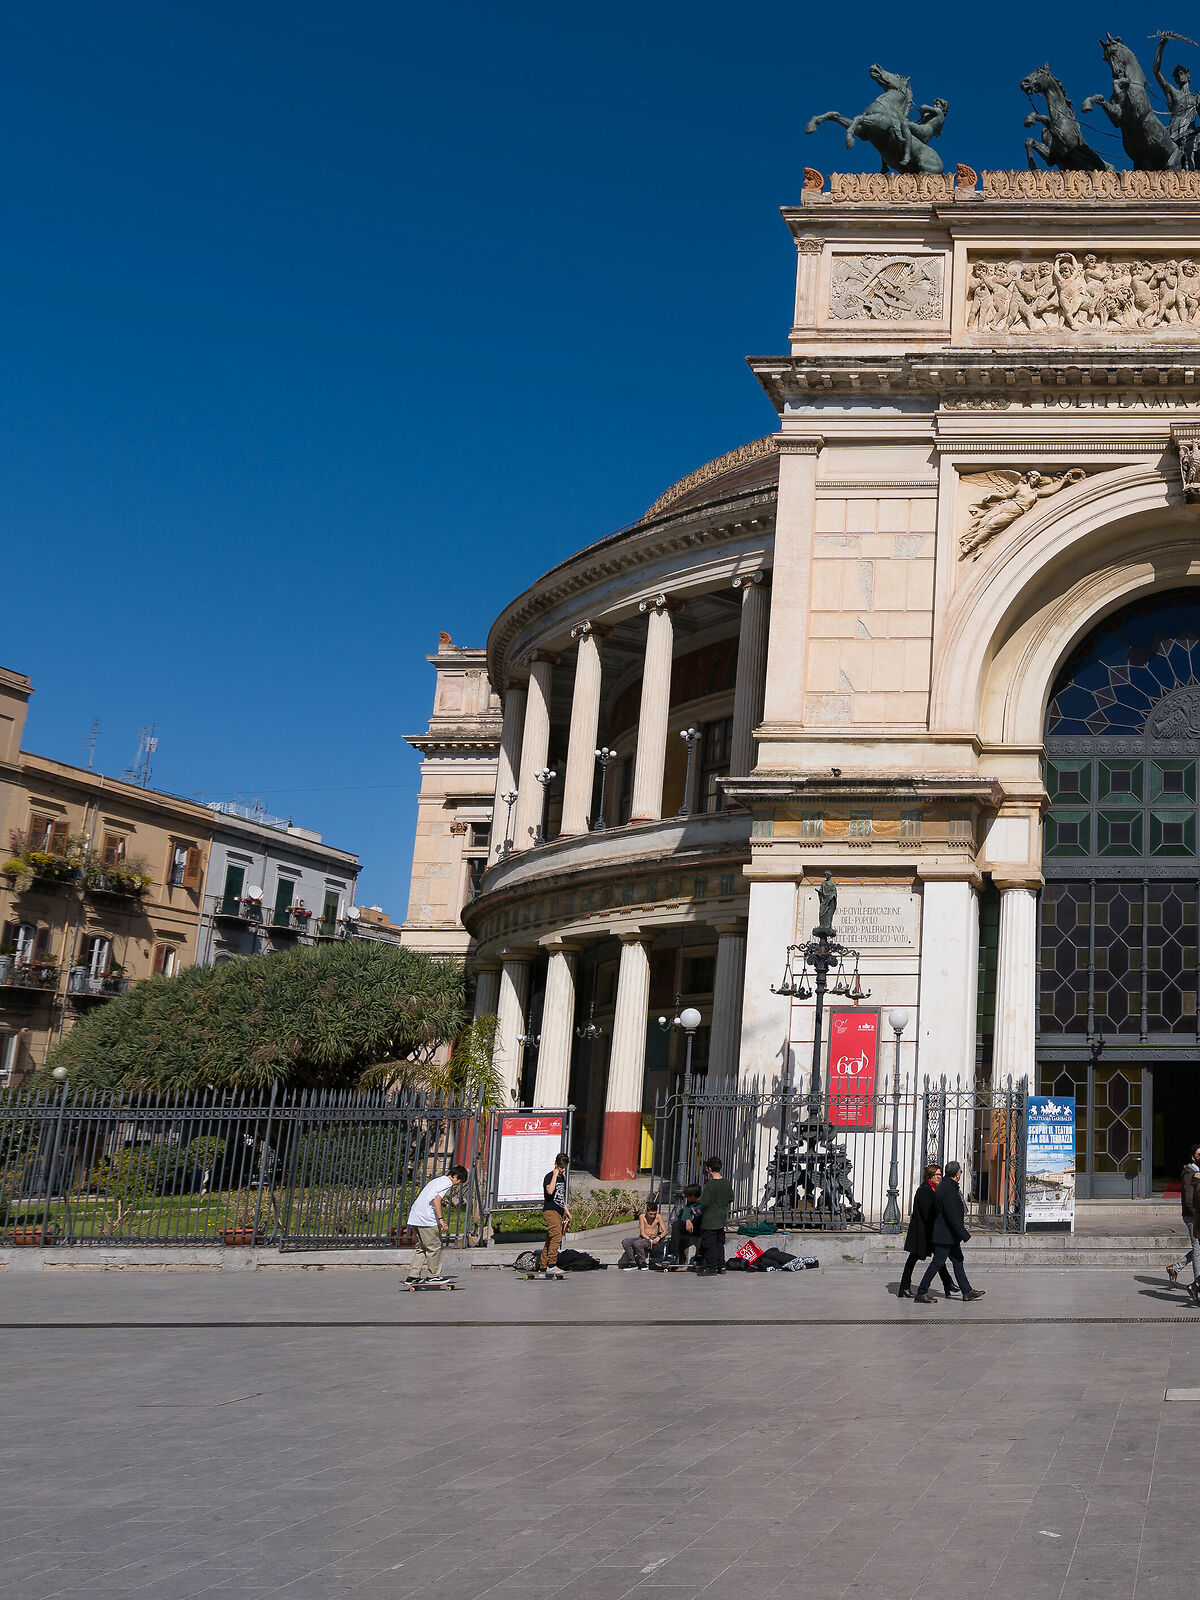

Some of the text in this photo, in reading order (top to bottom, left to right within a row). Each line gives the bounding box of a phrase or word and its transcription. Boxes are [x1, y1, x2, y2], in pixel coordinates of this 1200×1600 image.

[1041, 393, 1188, 409] POLITEAMA
[841, 916, 878, 924] DEL POPOLO
[861, 925, 905, 934] PALERMITANO
[1028, 1125, 1048, 1135] SCOPRI
[1055, 1125, 1072, 1135] TEATRO
[1050, 1134, 1072, 1144] TERRAZZA
